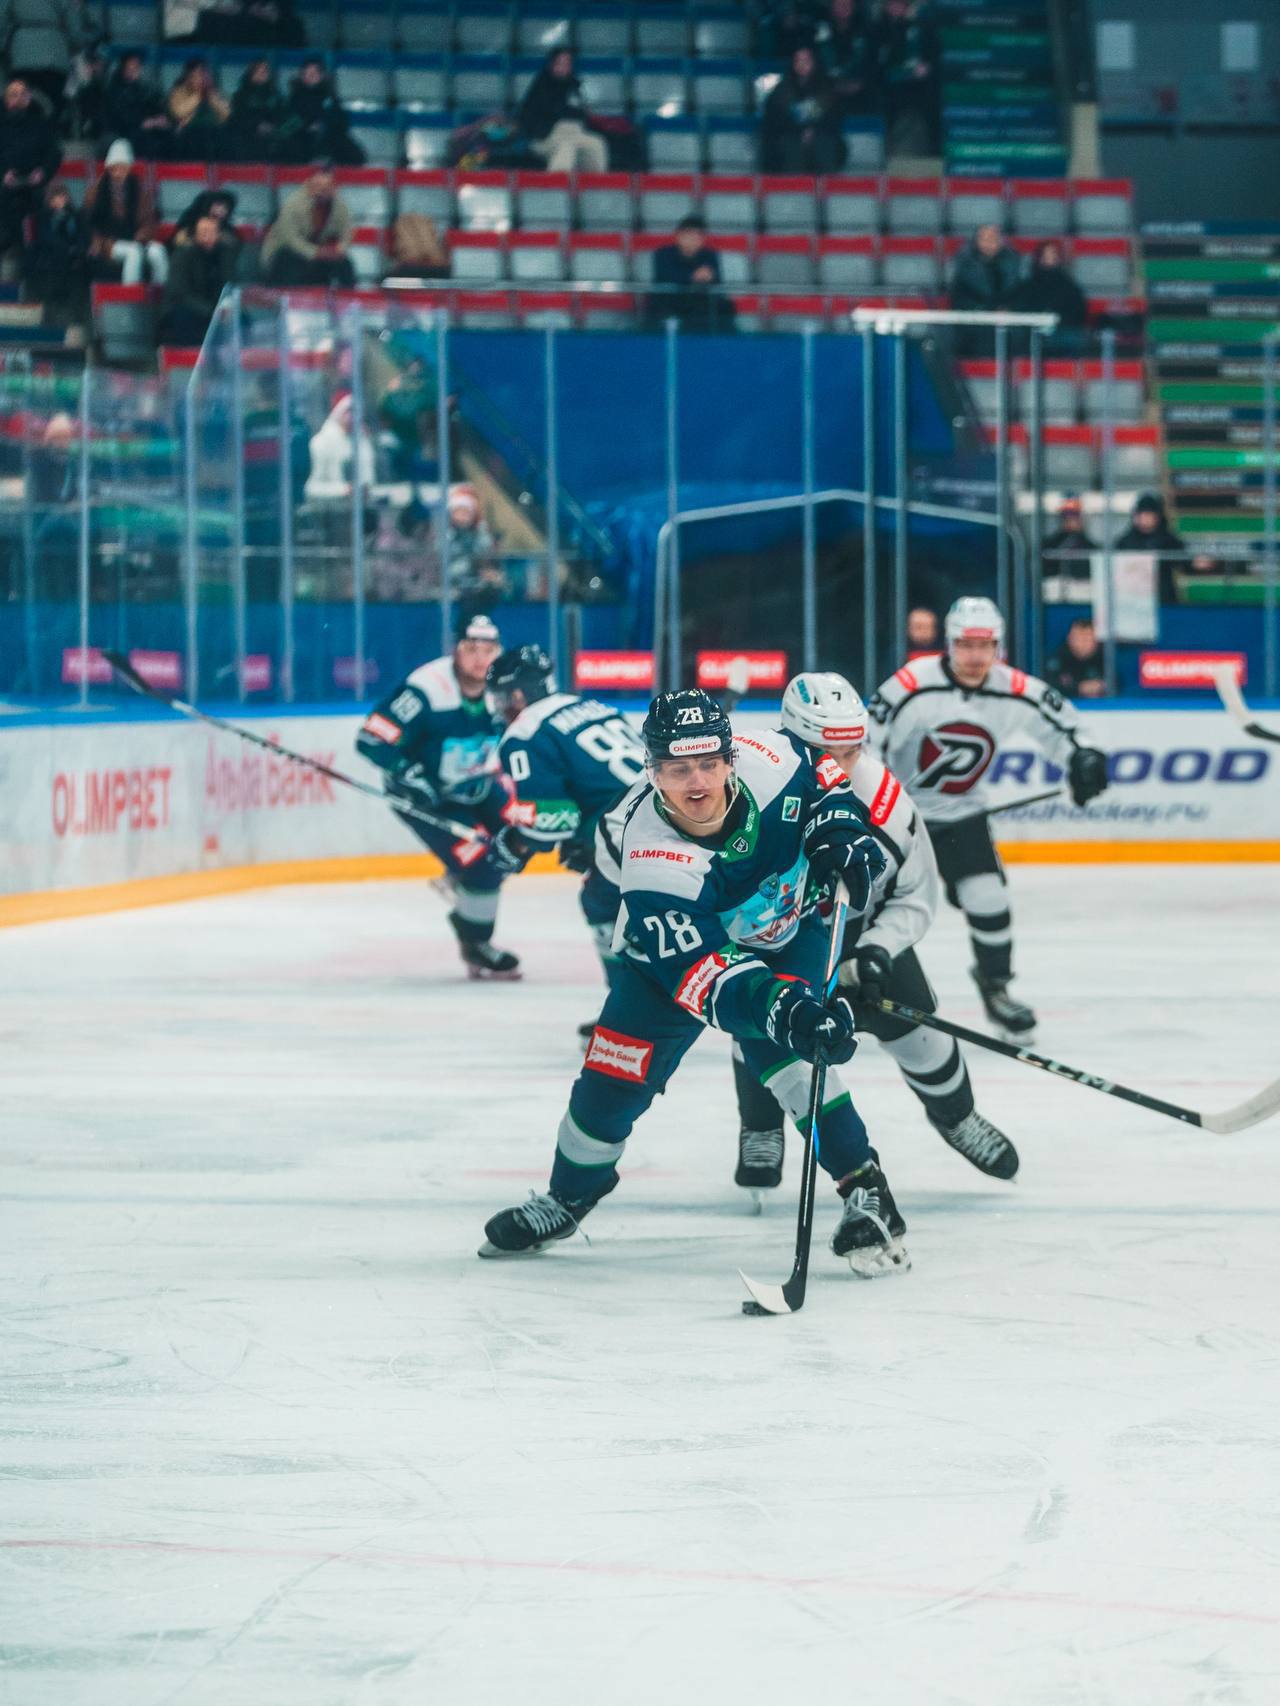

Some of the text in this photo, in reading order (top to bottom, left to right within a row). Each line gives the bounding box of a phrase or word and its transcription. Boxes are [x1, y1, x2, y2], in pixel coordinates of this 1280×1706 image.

[677, 707, 704, 725] 28
[673, 741, 718, 753] OLIMPBET
[52, 766, 173, 837] OLIMPBET
[630, 850, 694, 864] OLIMPBET
[643, 909, 703, 959] 28
